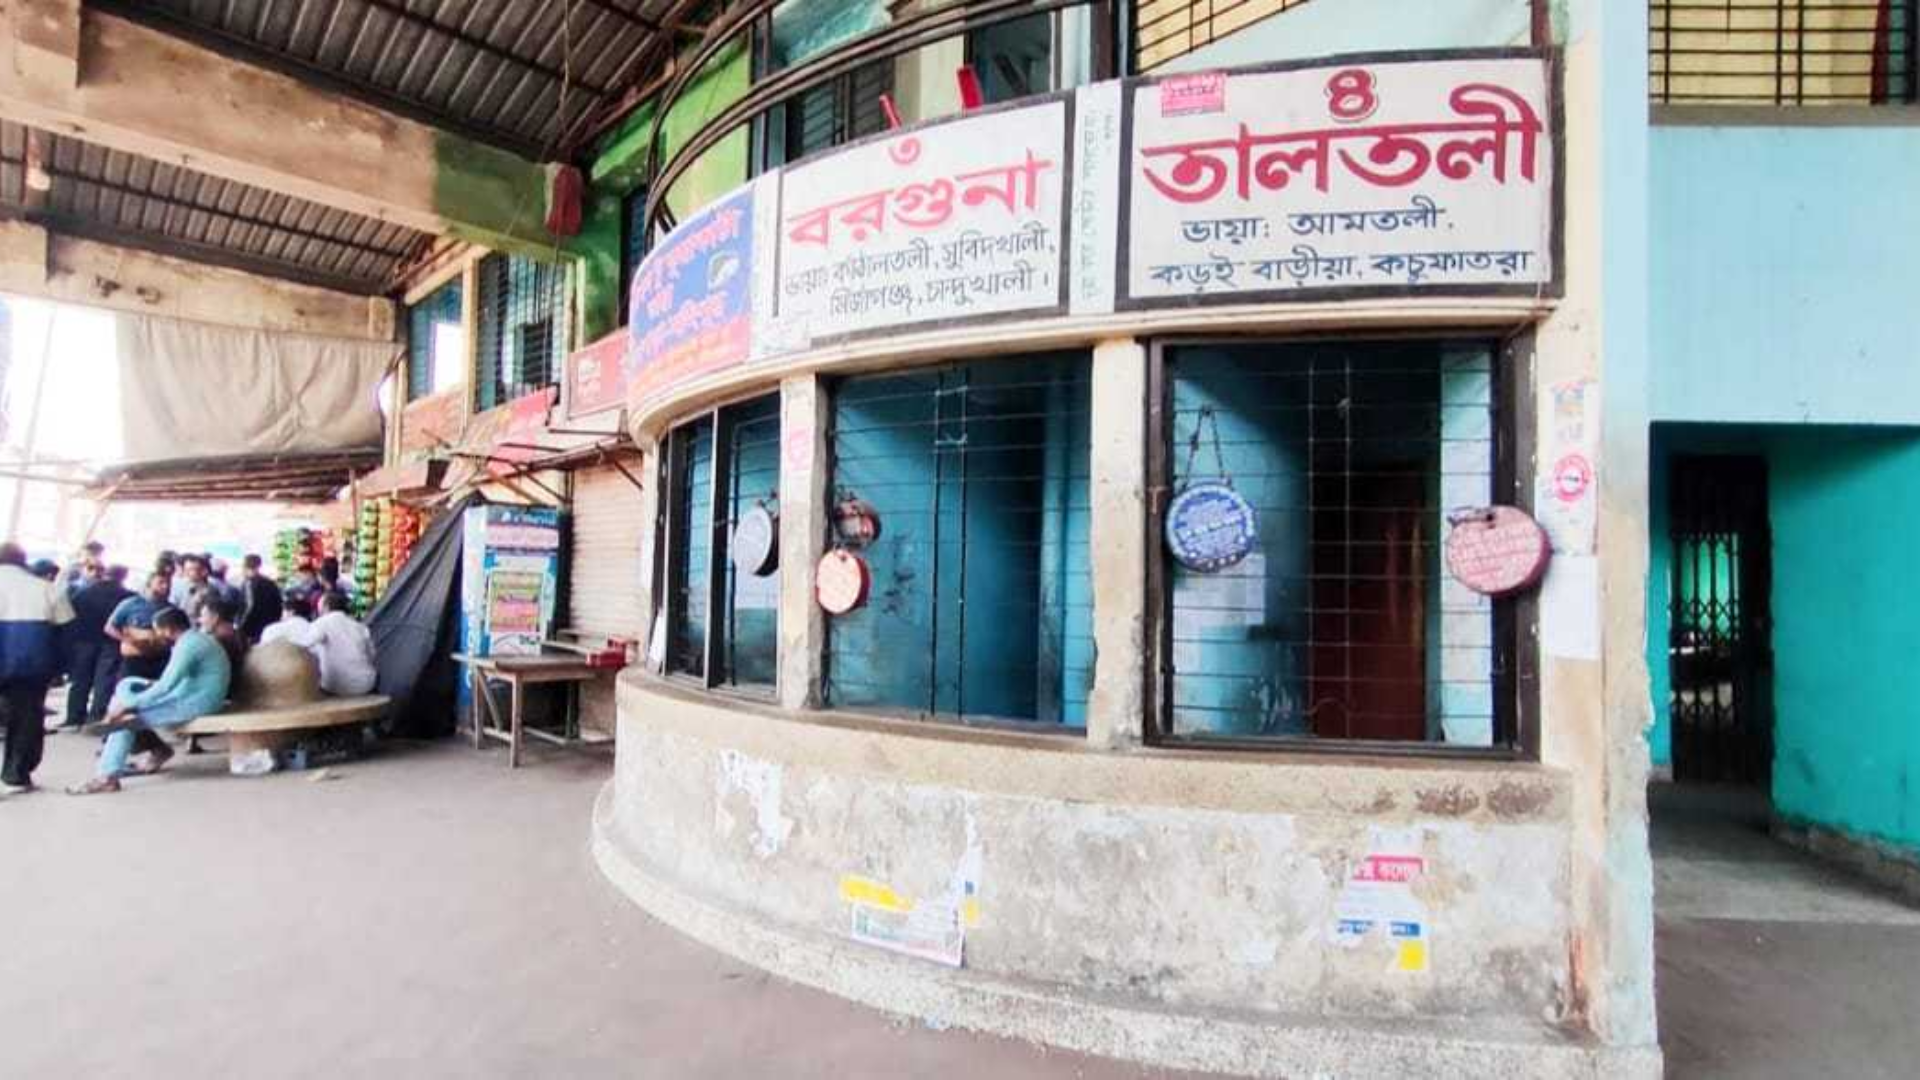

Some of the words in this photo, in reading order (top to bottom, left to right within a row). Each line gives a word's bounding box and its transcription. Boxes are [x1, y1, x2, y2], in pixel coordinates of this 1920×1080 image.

[1326, 68, 1377, 121] ৪
[888, 137, 922, 168] ৩
[1140, 83, 1543, 201] তালতলী
[786, 146, 1054, 248] বরগুনা
